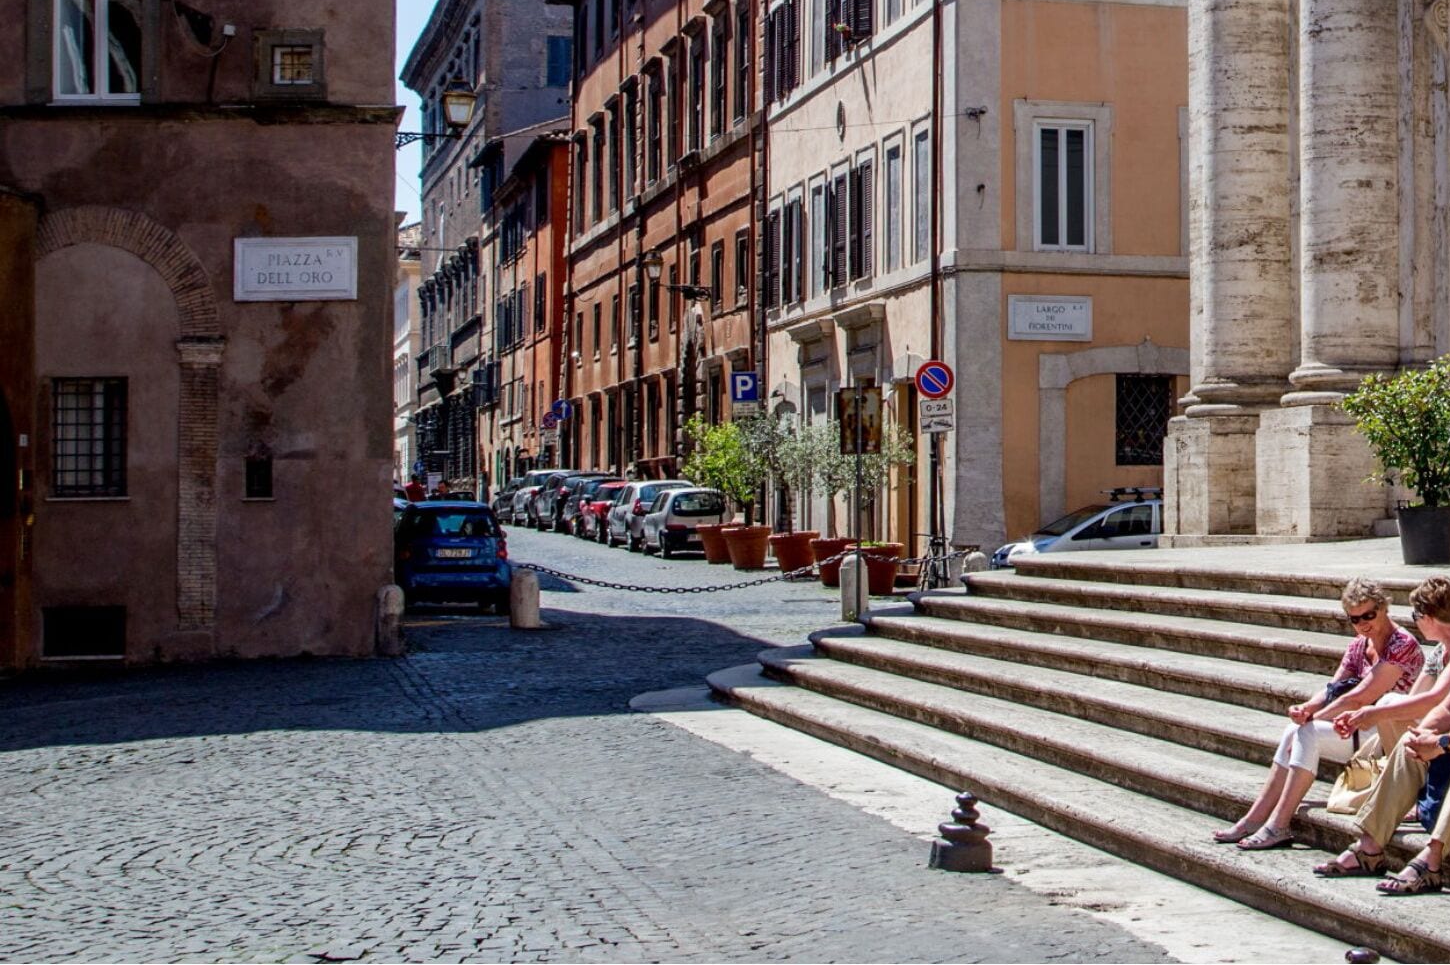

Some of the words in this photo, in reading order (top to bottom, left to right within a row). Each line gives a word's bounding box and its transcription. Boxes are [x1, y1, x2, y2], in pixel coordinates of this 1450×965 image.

[267, 254, 323, 266] PIAZZA
[299, 271, 334, 284] ORO
[1036, 305, 1066, 313] LARGO
[1028, 322, 1073, 331] FIORENTINI
[735, 375, 754, 399] P
